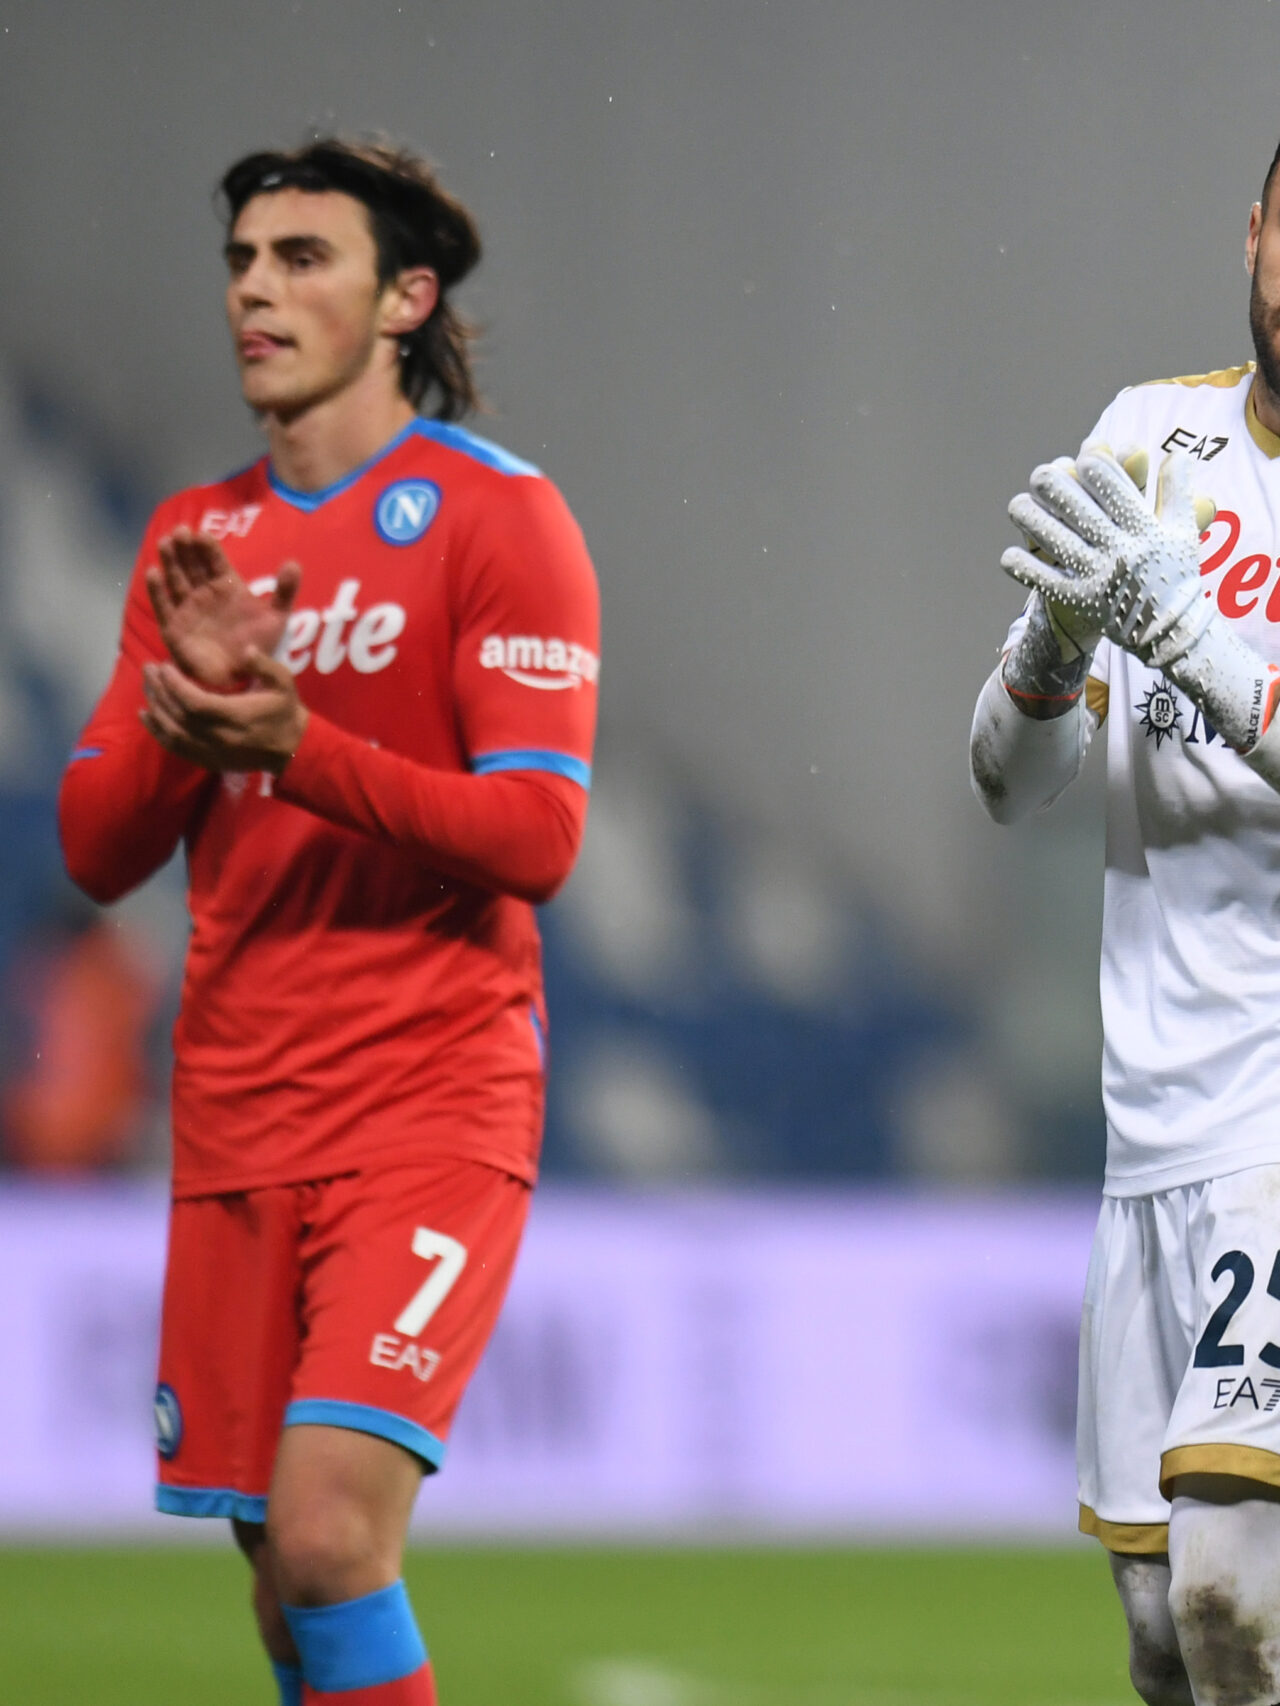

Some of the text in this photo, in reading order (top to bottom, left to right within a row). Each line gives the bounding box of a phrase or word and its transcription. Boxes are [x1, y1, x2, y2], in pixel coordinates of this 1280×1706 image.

[1161, 427, 1229, 462] EA7
[391, 493, 425, 529] N
[248, 577, 407, 675] ete
[394, 1226, 467, 1338] 7
[369, 1333, 441, 1383] EA7
